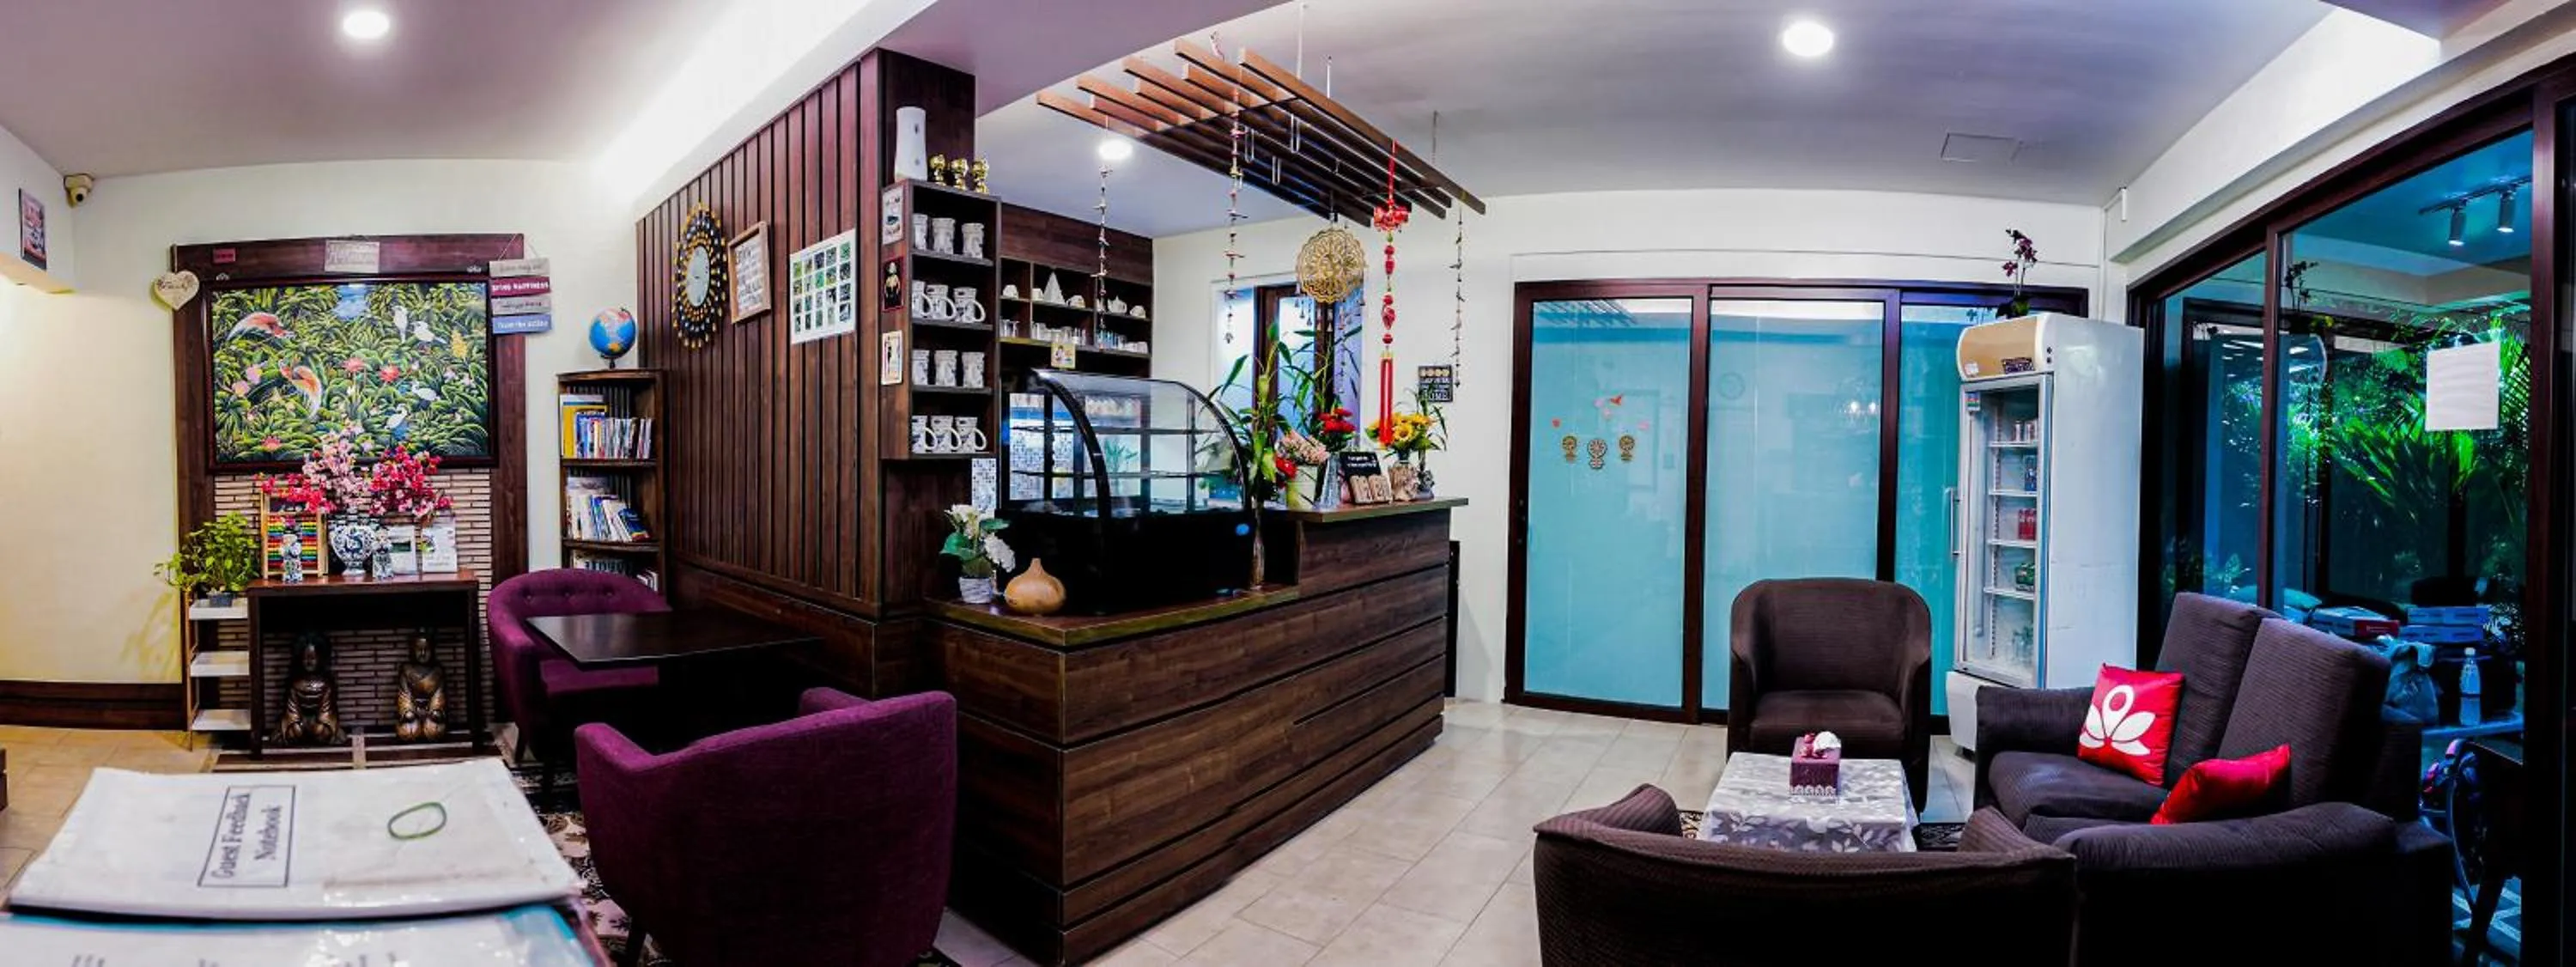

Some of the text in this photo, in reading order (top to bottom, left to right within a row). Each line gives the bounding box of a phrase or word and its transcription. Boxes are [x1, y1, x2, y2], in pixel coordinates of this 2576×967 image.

[210, 794, 251, 879] Guest Feedback
[253, 806, 283, 861] Notebook
